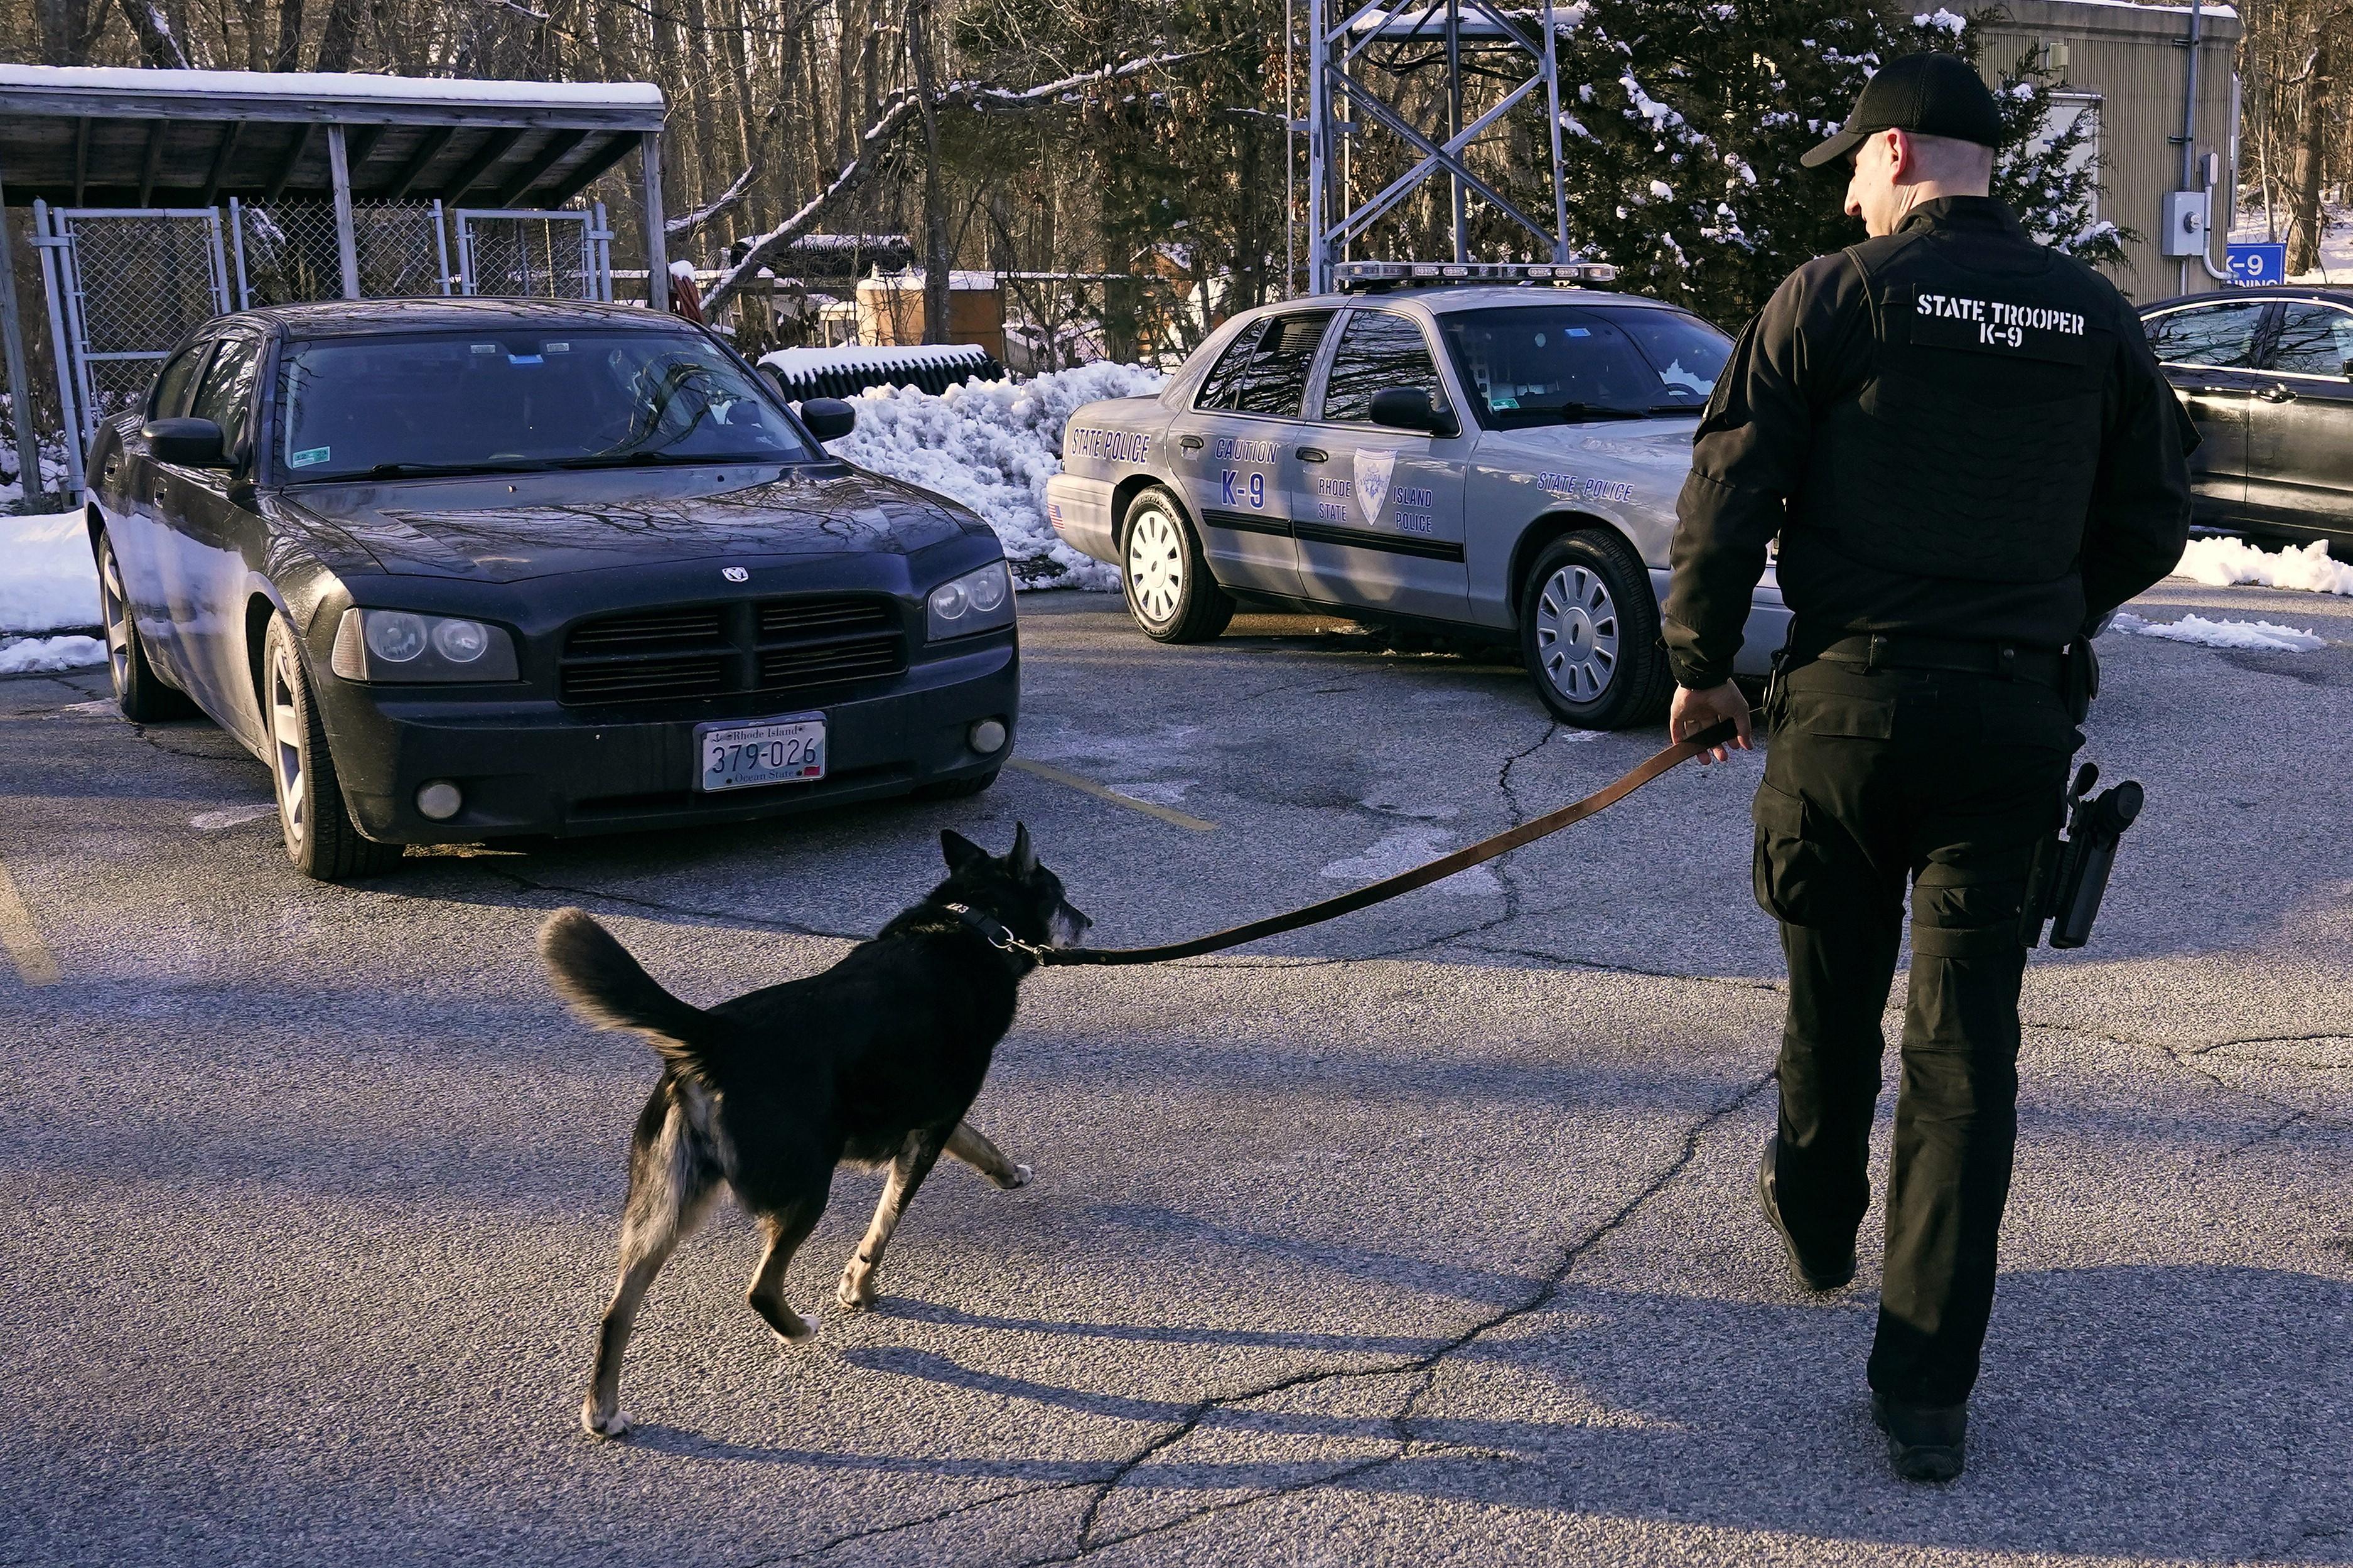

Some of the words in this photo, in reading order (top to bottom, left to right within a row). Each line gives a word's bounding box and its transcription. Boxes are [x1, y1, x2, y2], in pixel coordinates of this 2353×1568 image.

[1917, 294, 1985, 322] STATE
[1991, 302, 2084, 336] TROOPER
[1979, 323, 2023, 347] K-9
[1071, 427, 1103, 458] STATE
[1103, 429, 1151, 464] POLICE
[1215, 438, 1278, 464] CAUTION
[1221, 469, 1265, 510] K-9
[1318, 477, 1350, 497] RHODE
[1392, 485, 1433, 508] ISLAND
[1537, 471, 1578, 494] STATE
[1583, 478, 1634, 502] POLICE
[1318, 502, 1347, 522] STATE
[1394, 512, 1433, 534] POLICE
[733, 731, 764, 741] Rhode
[768, 726, 798, 738] Island
[712, 737, 816, 774] 379-026
[735, 773, 767, 783] Ocean
[769, 770, 794, 780] State
